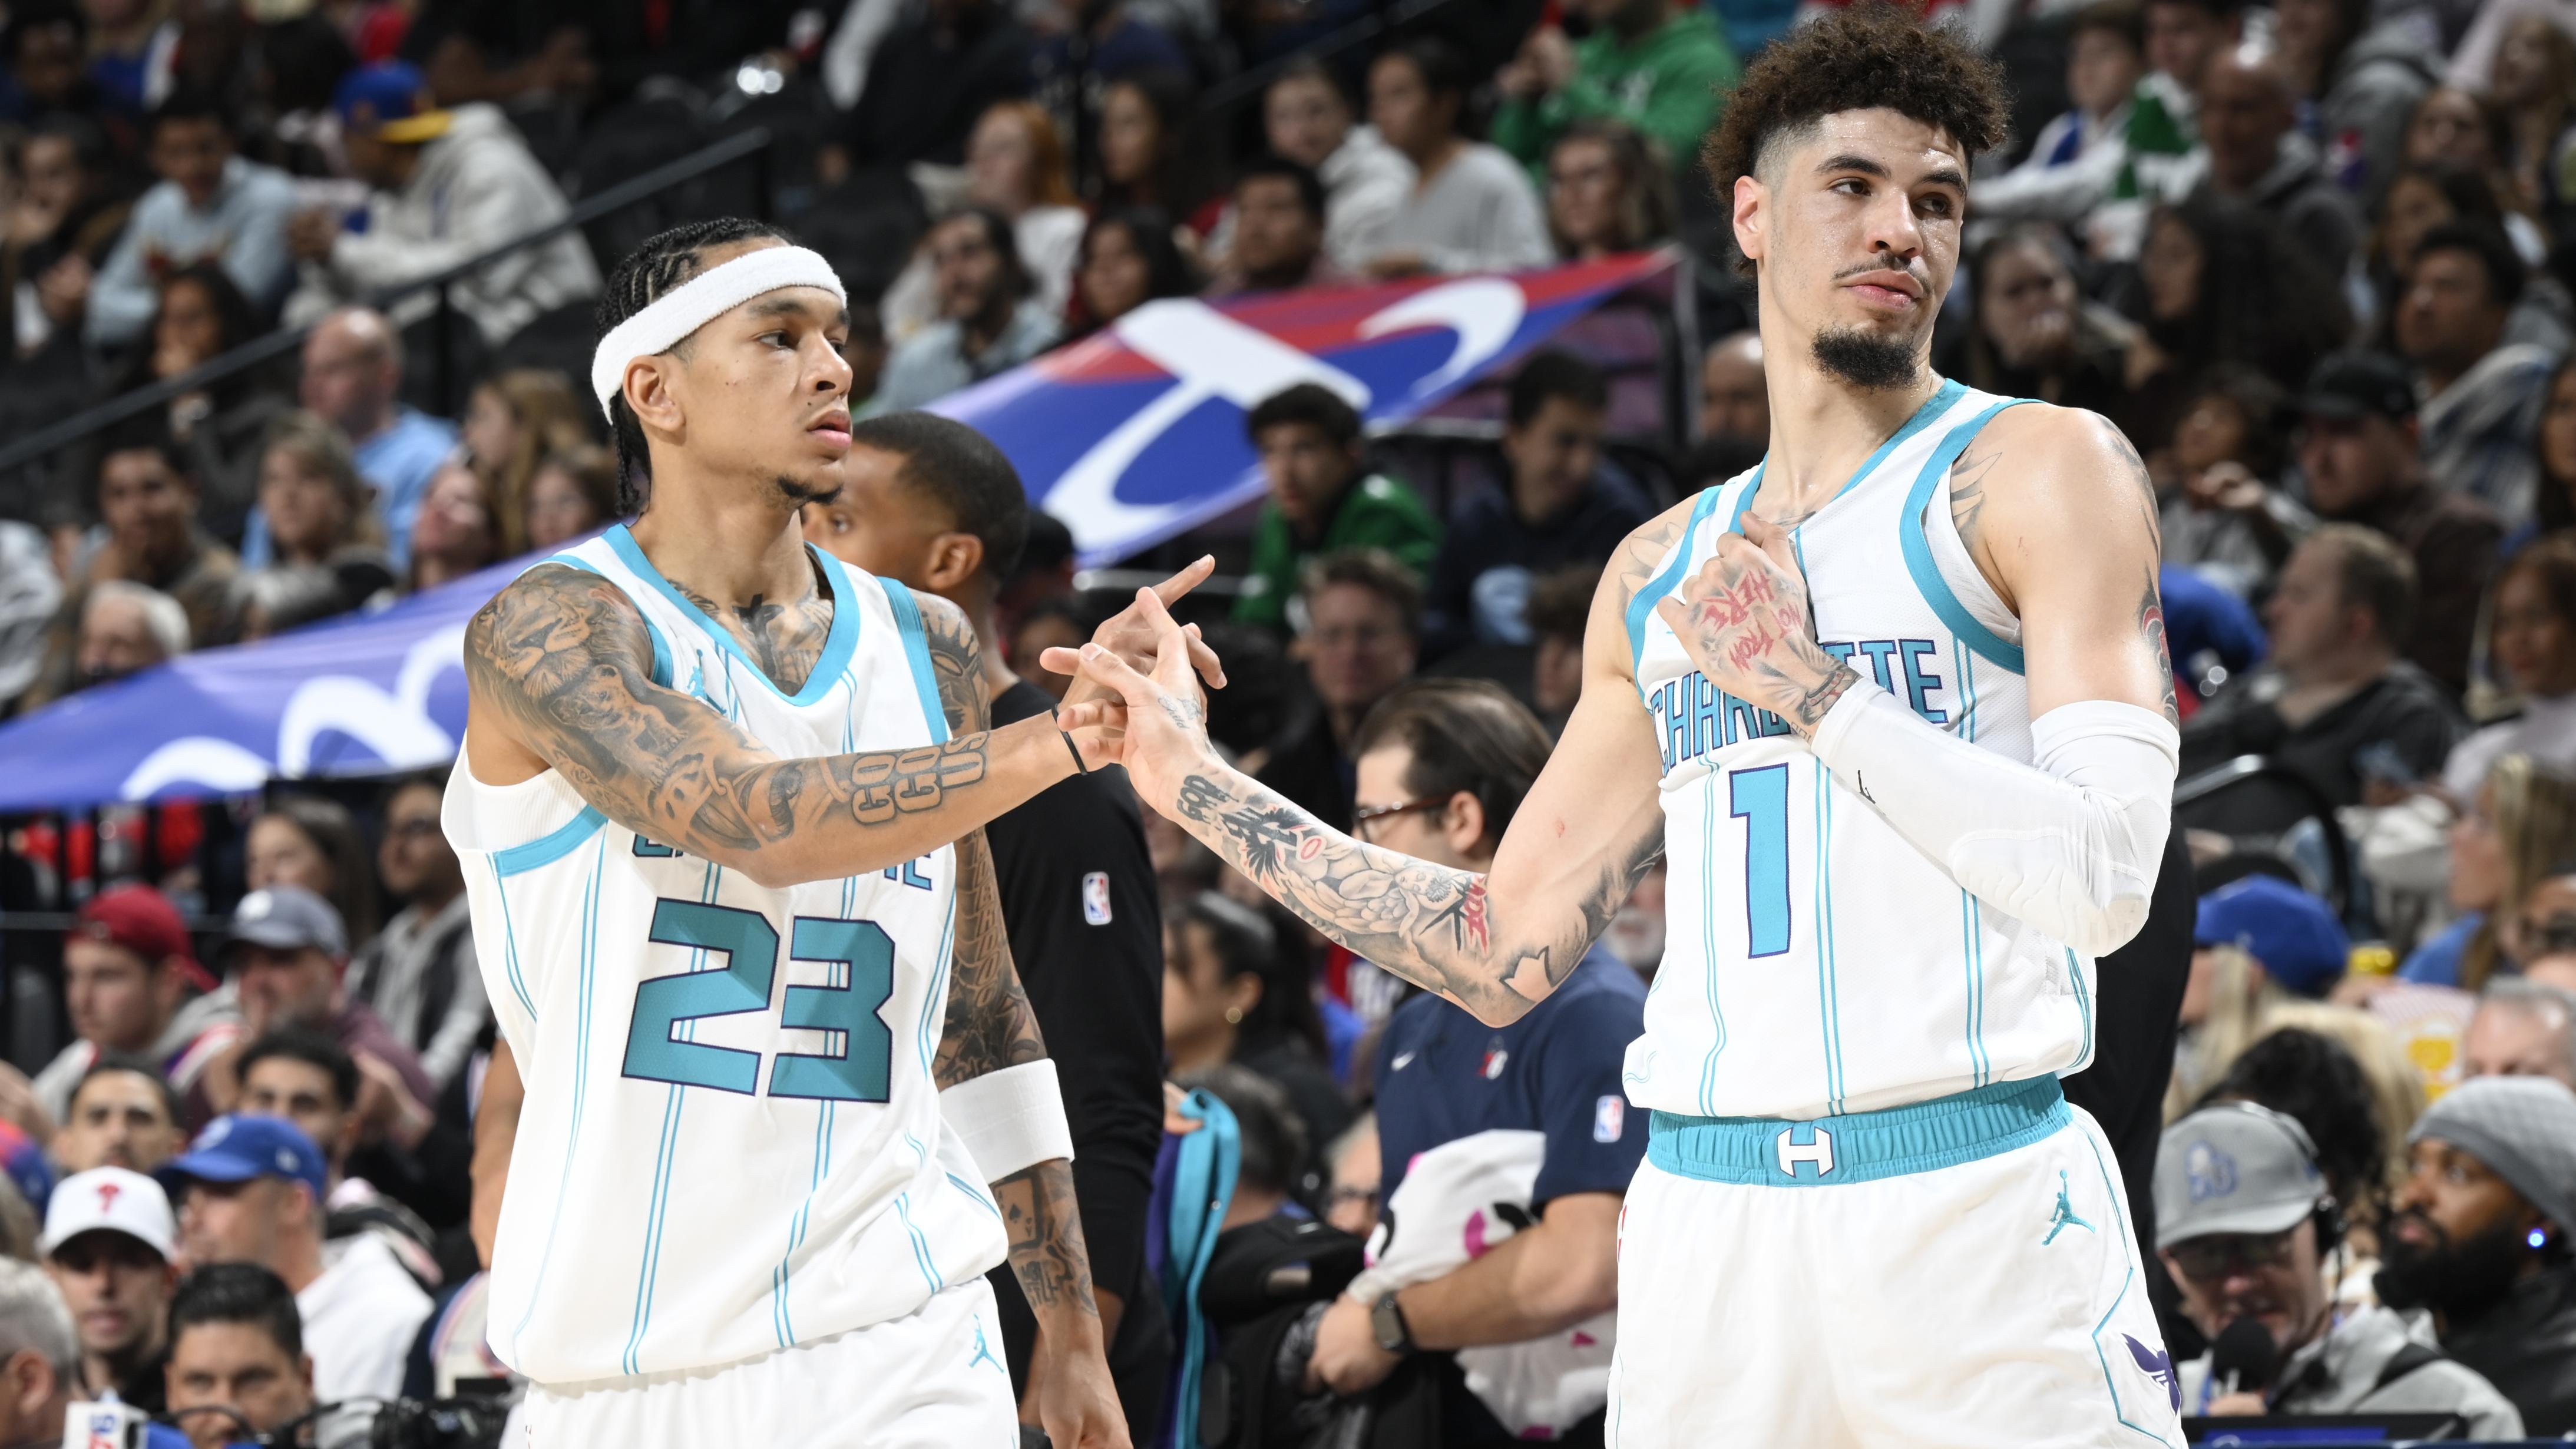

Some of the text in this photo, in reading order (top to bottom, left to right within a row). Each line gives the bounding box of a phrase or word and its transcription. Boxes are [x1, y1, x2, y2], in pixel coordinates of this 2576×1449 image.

[1699, 568, 1775, 634] HERE
[1650, 639, 1949, 779] CHARTE
[852, 753, 898, 826] GO
[894, 746, 942, 813] GO
[1729, 762, 1792, 959] 1
[621, 896, 895, 1104] 23
